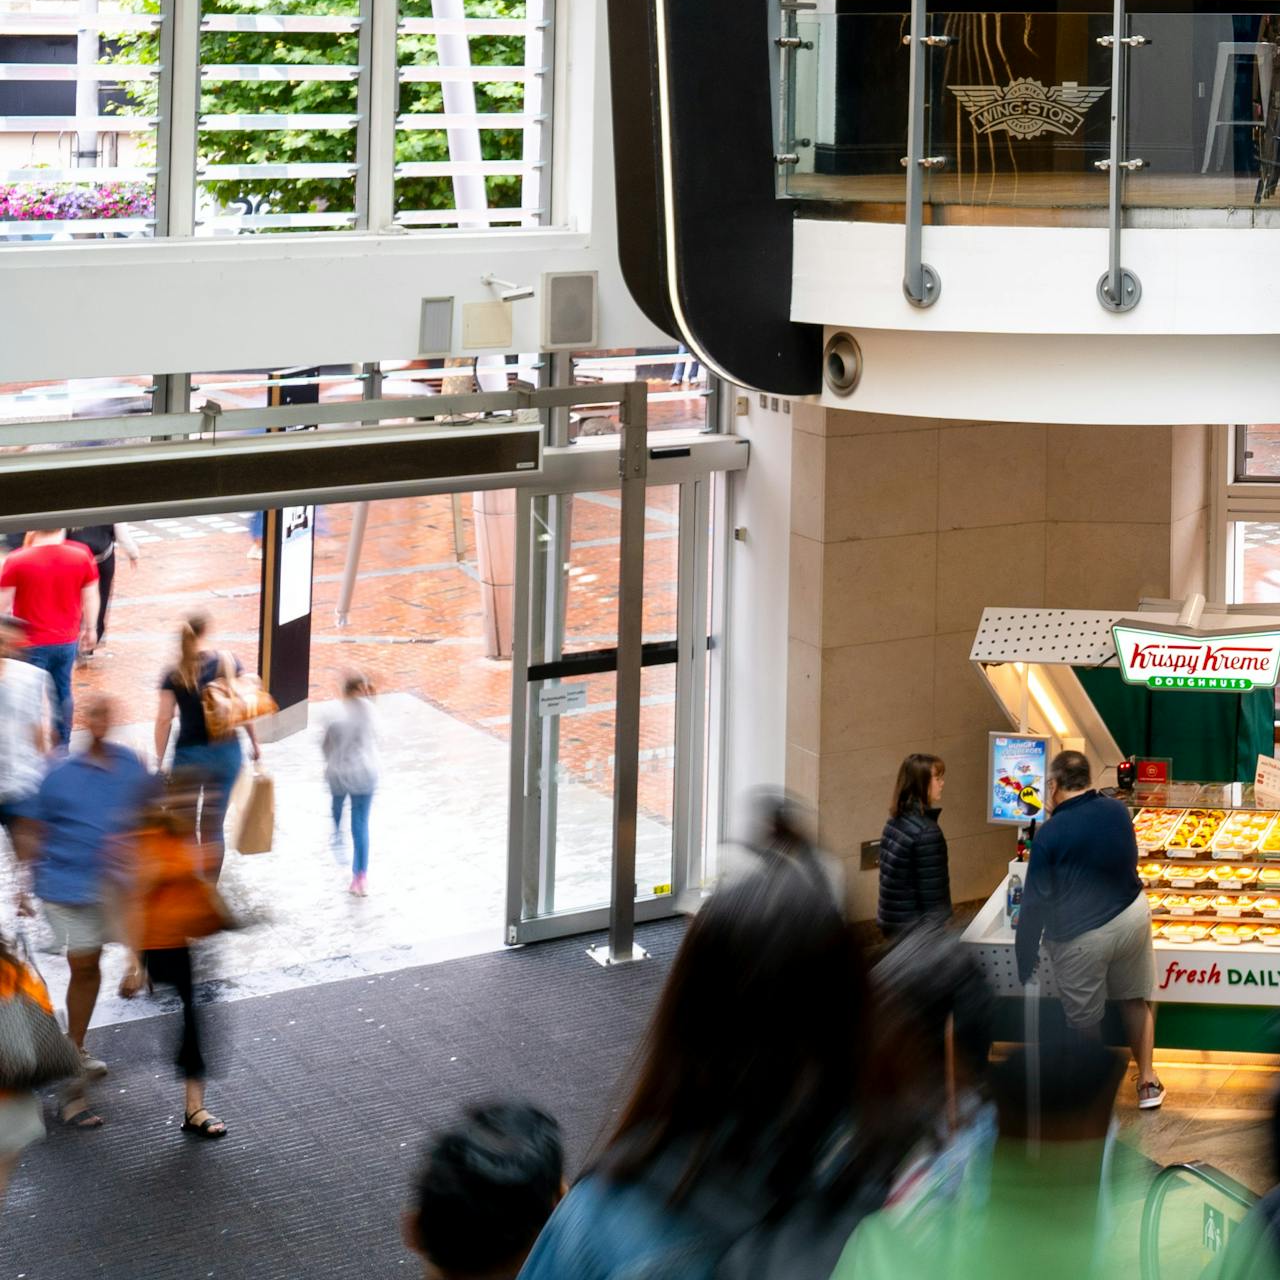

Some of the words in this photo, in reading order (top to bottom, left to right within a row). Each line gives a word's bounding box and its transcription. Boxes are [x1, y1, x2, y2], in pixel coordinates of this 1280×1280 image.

[1130, 642, 1202, 674] Krispy
[1202, 645, 1273, 671] Kreme
[1155, 677, 1246, 688] DOUGHNUTS
[1159, 960, 1222, 990] fresh
